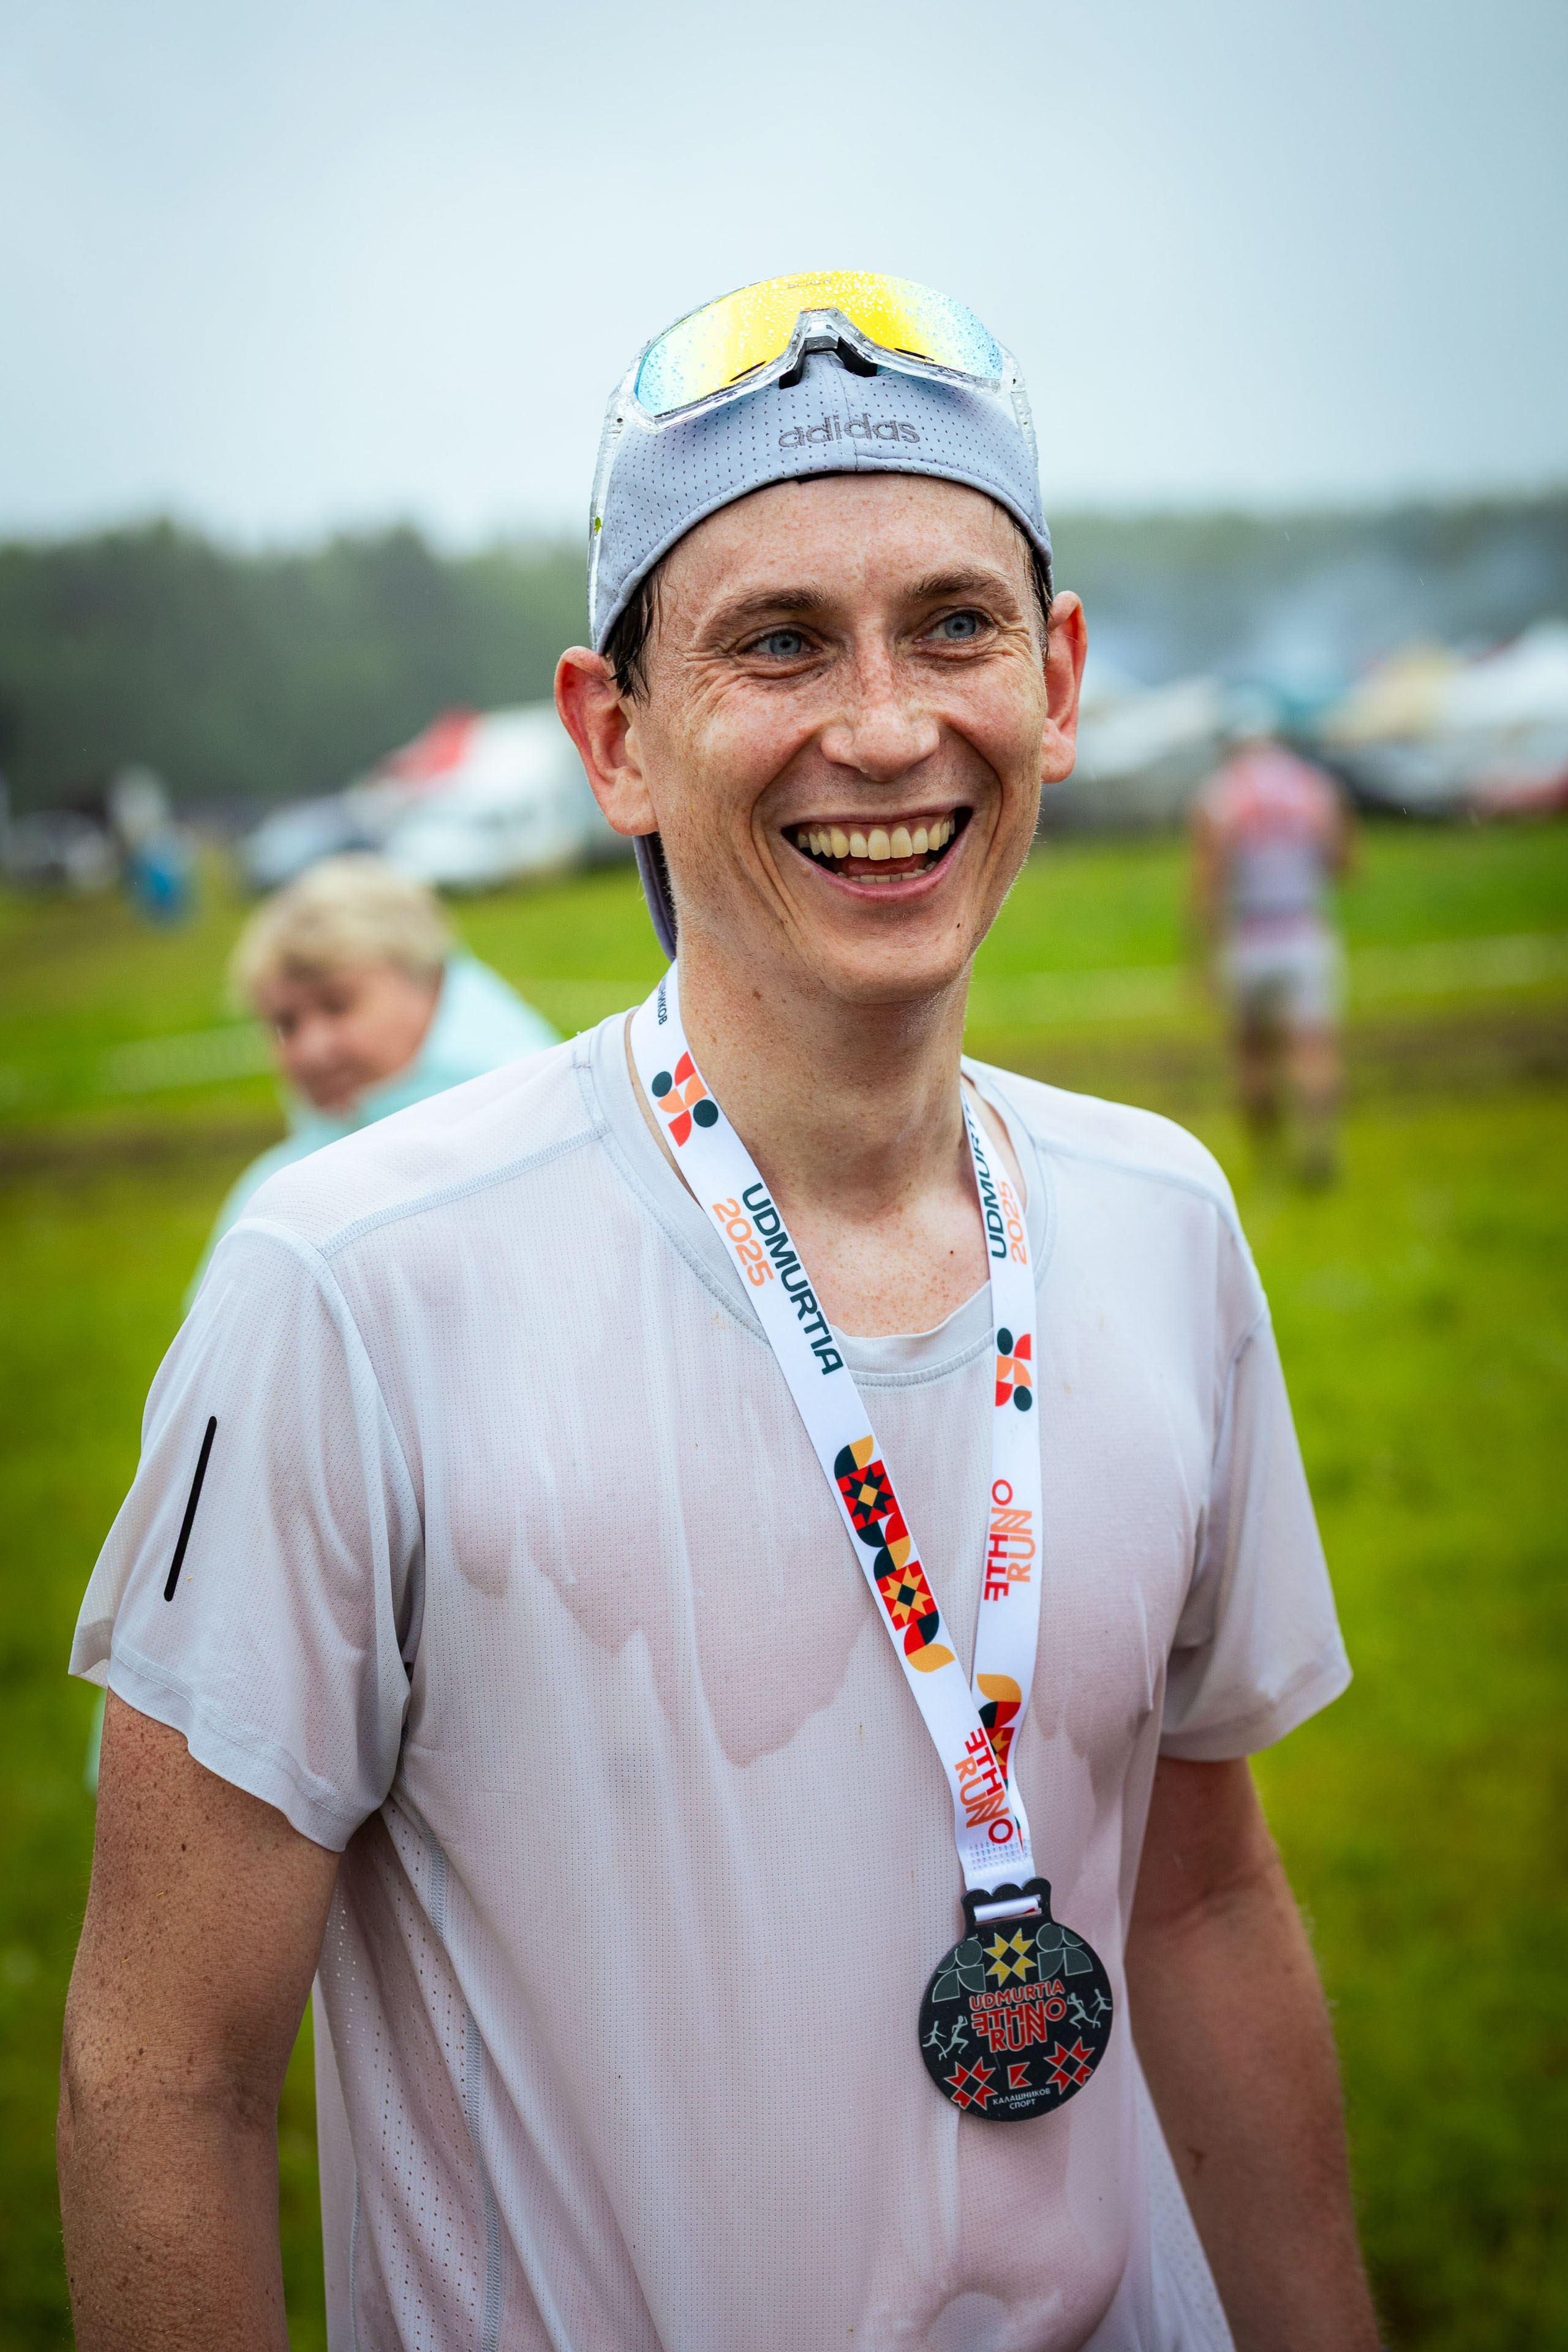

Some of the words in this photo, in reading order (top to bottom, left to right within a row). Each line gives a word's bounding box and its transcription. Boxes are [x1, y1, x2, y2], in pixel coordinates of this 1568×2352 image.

[778, 413, 920, 447] adidas
[712, 1197, 774, 1287] 2025
[995, 1180, 1027, 1265] 2025
[742, 1182, 844, 1375] UDMURTIA
[1006, 1509, 1036, 1583] RUN
[954, 1755, 991, 1828] RUN
[969, 1979, 1065, 2011] UDMURTIA
[990, 2020, 1047, 2053] RUN
[993, 2088, 1050, 2105] КАЛАШНИКОВ
[1009, 2099, 1035, 2109] СПОРТ
